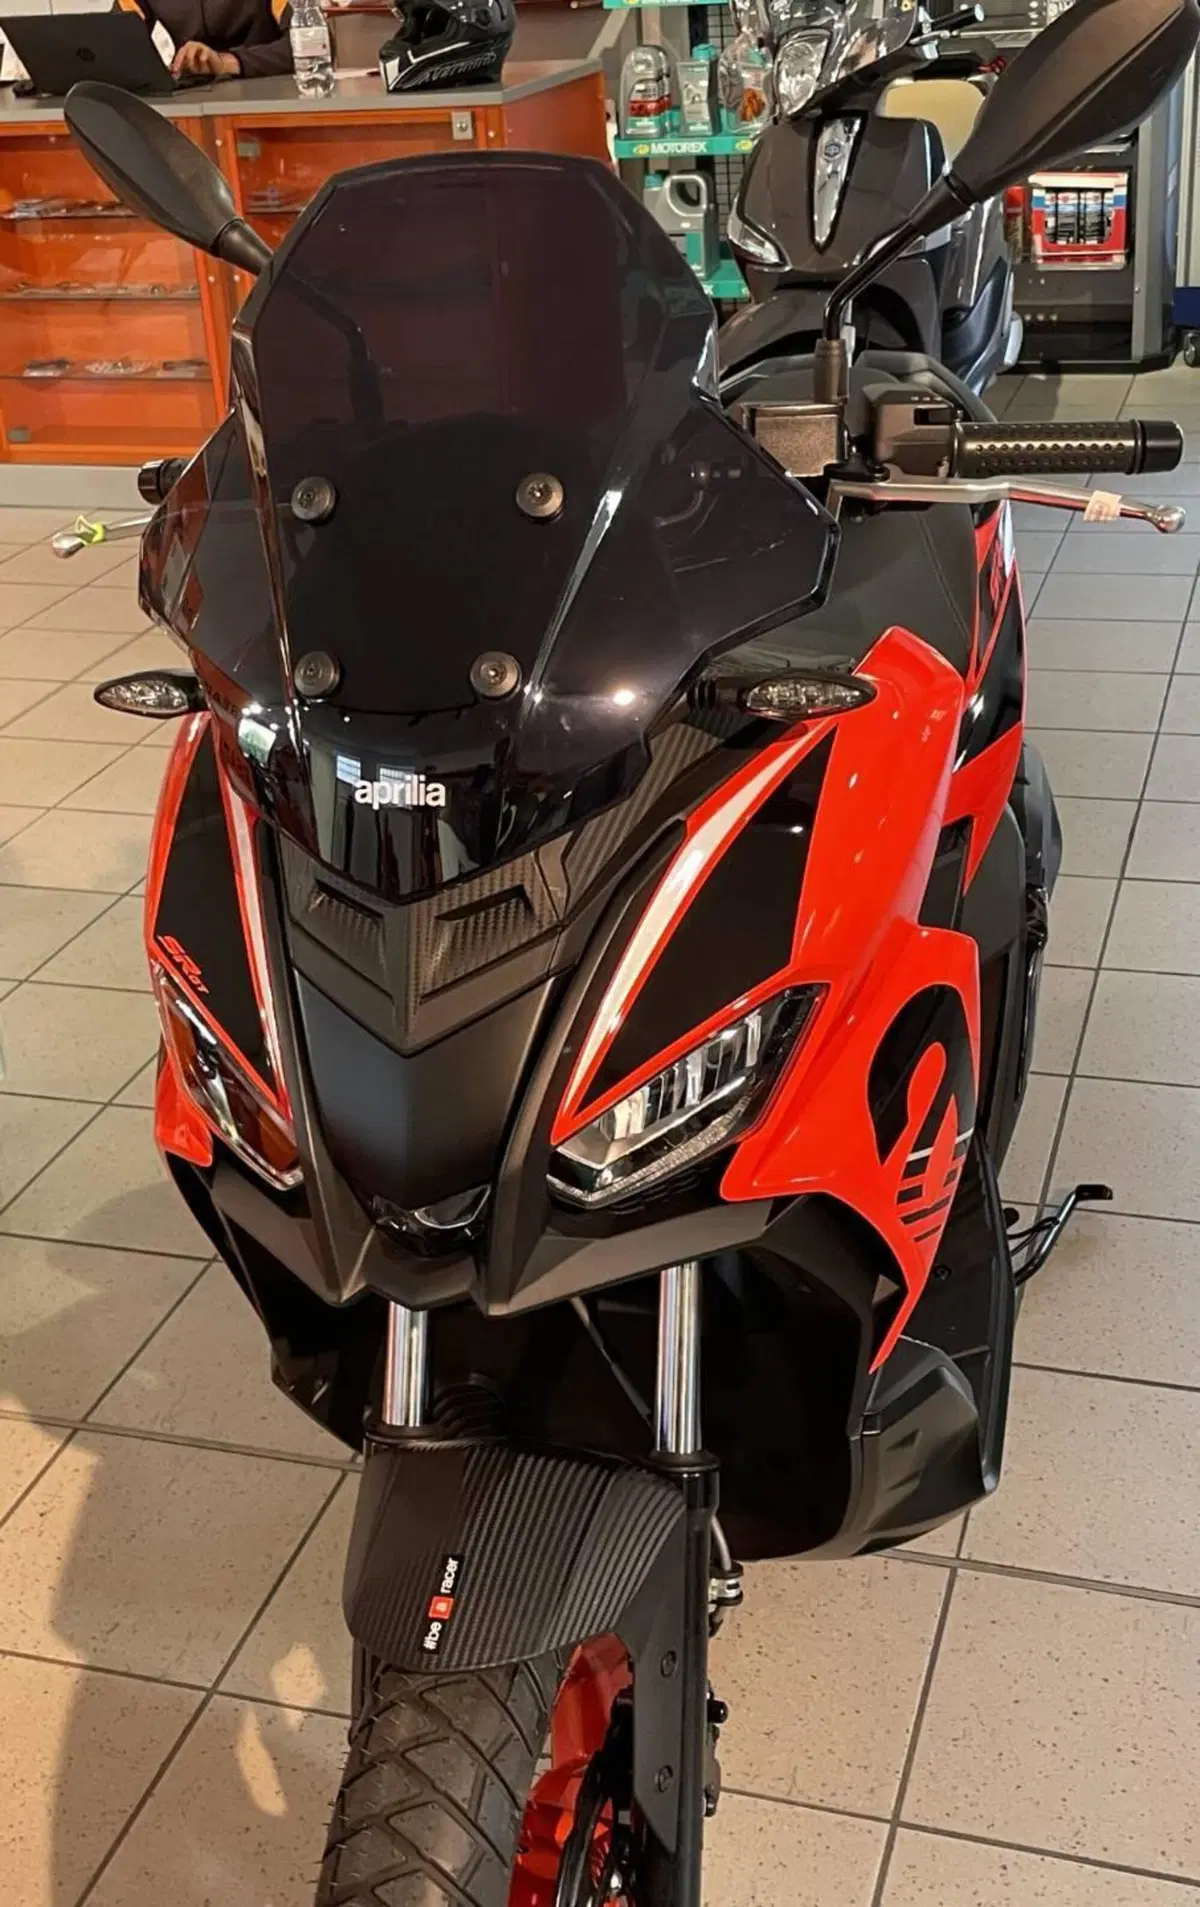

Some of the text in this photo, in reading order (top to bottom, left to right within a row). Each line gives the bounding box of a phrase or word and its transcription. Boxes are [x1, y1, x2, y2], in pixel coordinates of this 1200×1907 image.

[651, 142, 708, 154] MOTOREX
[354, 774, 446, 810] aprilia
[423, 1621, 442, 1650] #be
[440, 1557, 459, 1594] racer
